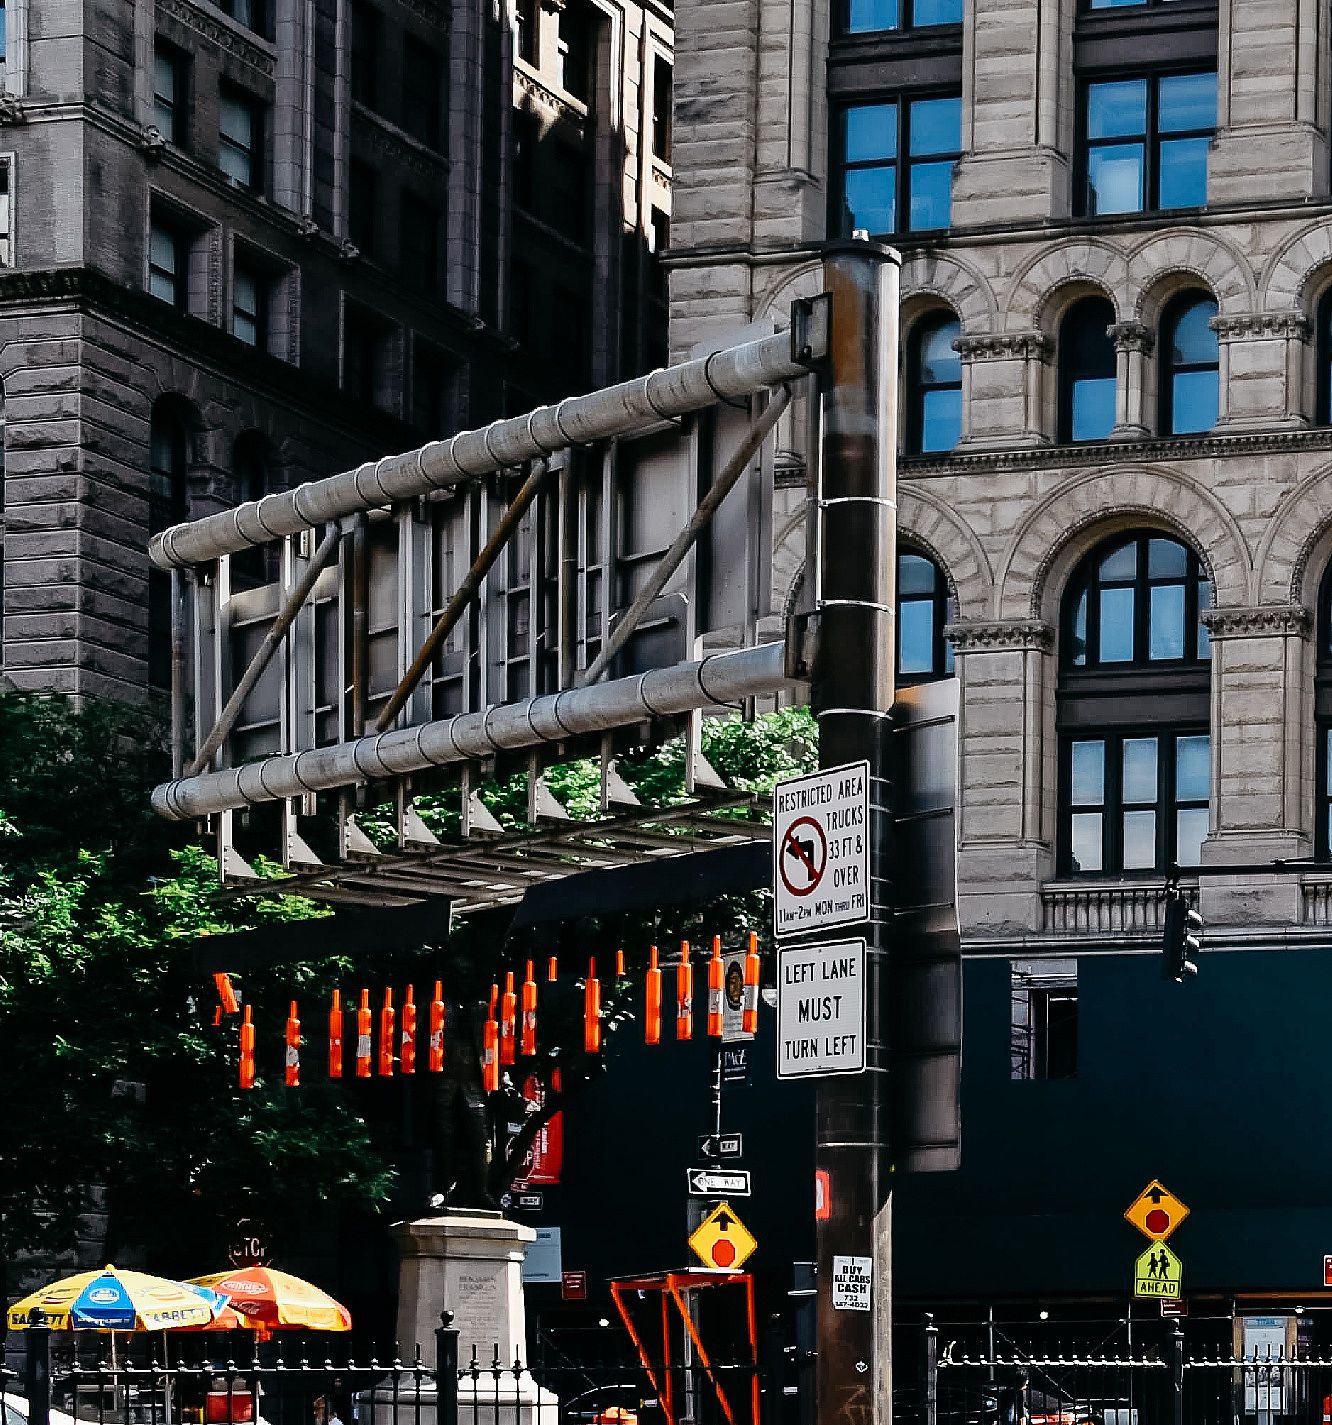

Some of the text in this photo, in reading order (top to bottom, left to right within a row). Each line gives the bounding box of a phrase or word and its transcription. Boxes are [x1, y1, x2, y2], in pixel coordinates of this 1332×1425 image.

[778, 776, 863, 814] RESTRICTED AREA
[826, 804, 864, 832] TRUCKS
[828, 834, 864, 860] 33 FT &
[833, 865, 859, 888] OVER
[815, 900, 833, 916] MON
[851, 893, 865, 909] FRI
[785, 957, 857, 985] LEFT LANE
[798, 995, 843, 1024] MUST
[784, 1034, 857, 1061] TURN LEFT
[697, 1177, 742, 1187] ONE WAY
[842, 1265, 863, 1275] BUY
[848, 1275, 871, 1285] CARS
[837, 1283, 867, 1294] CASH
[1140, 1281, 1176, 1294] AHEAD
